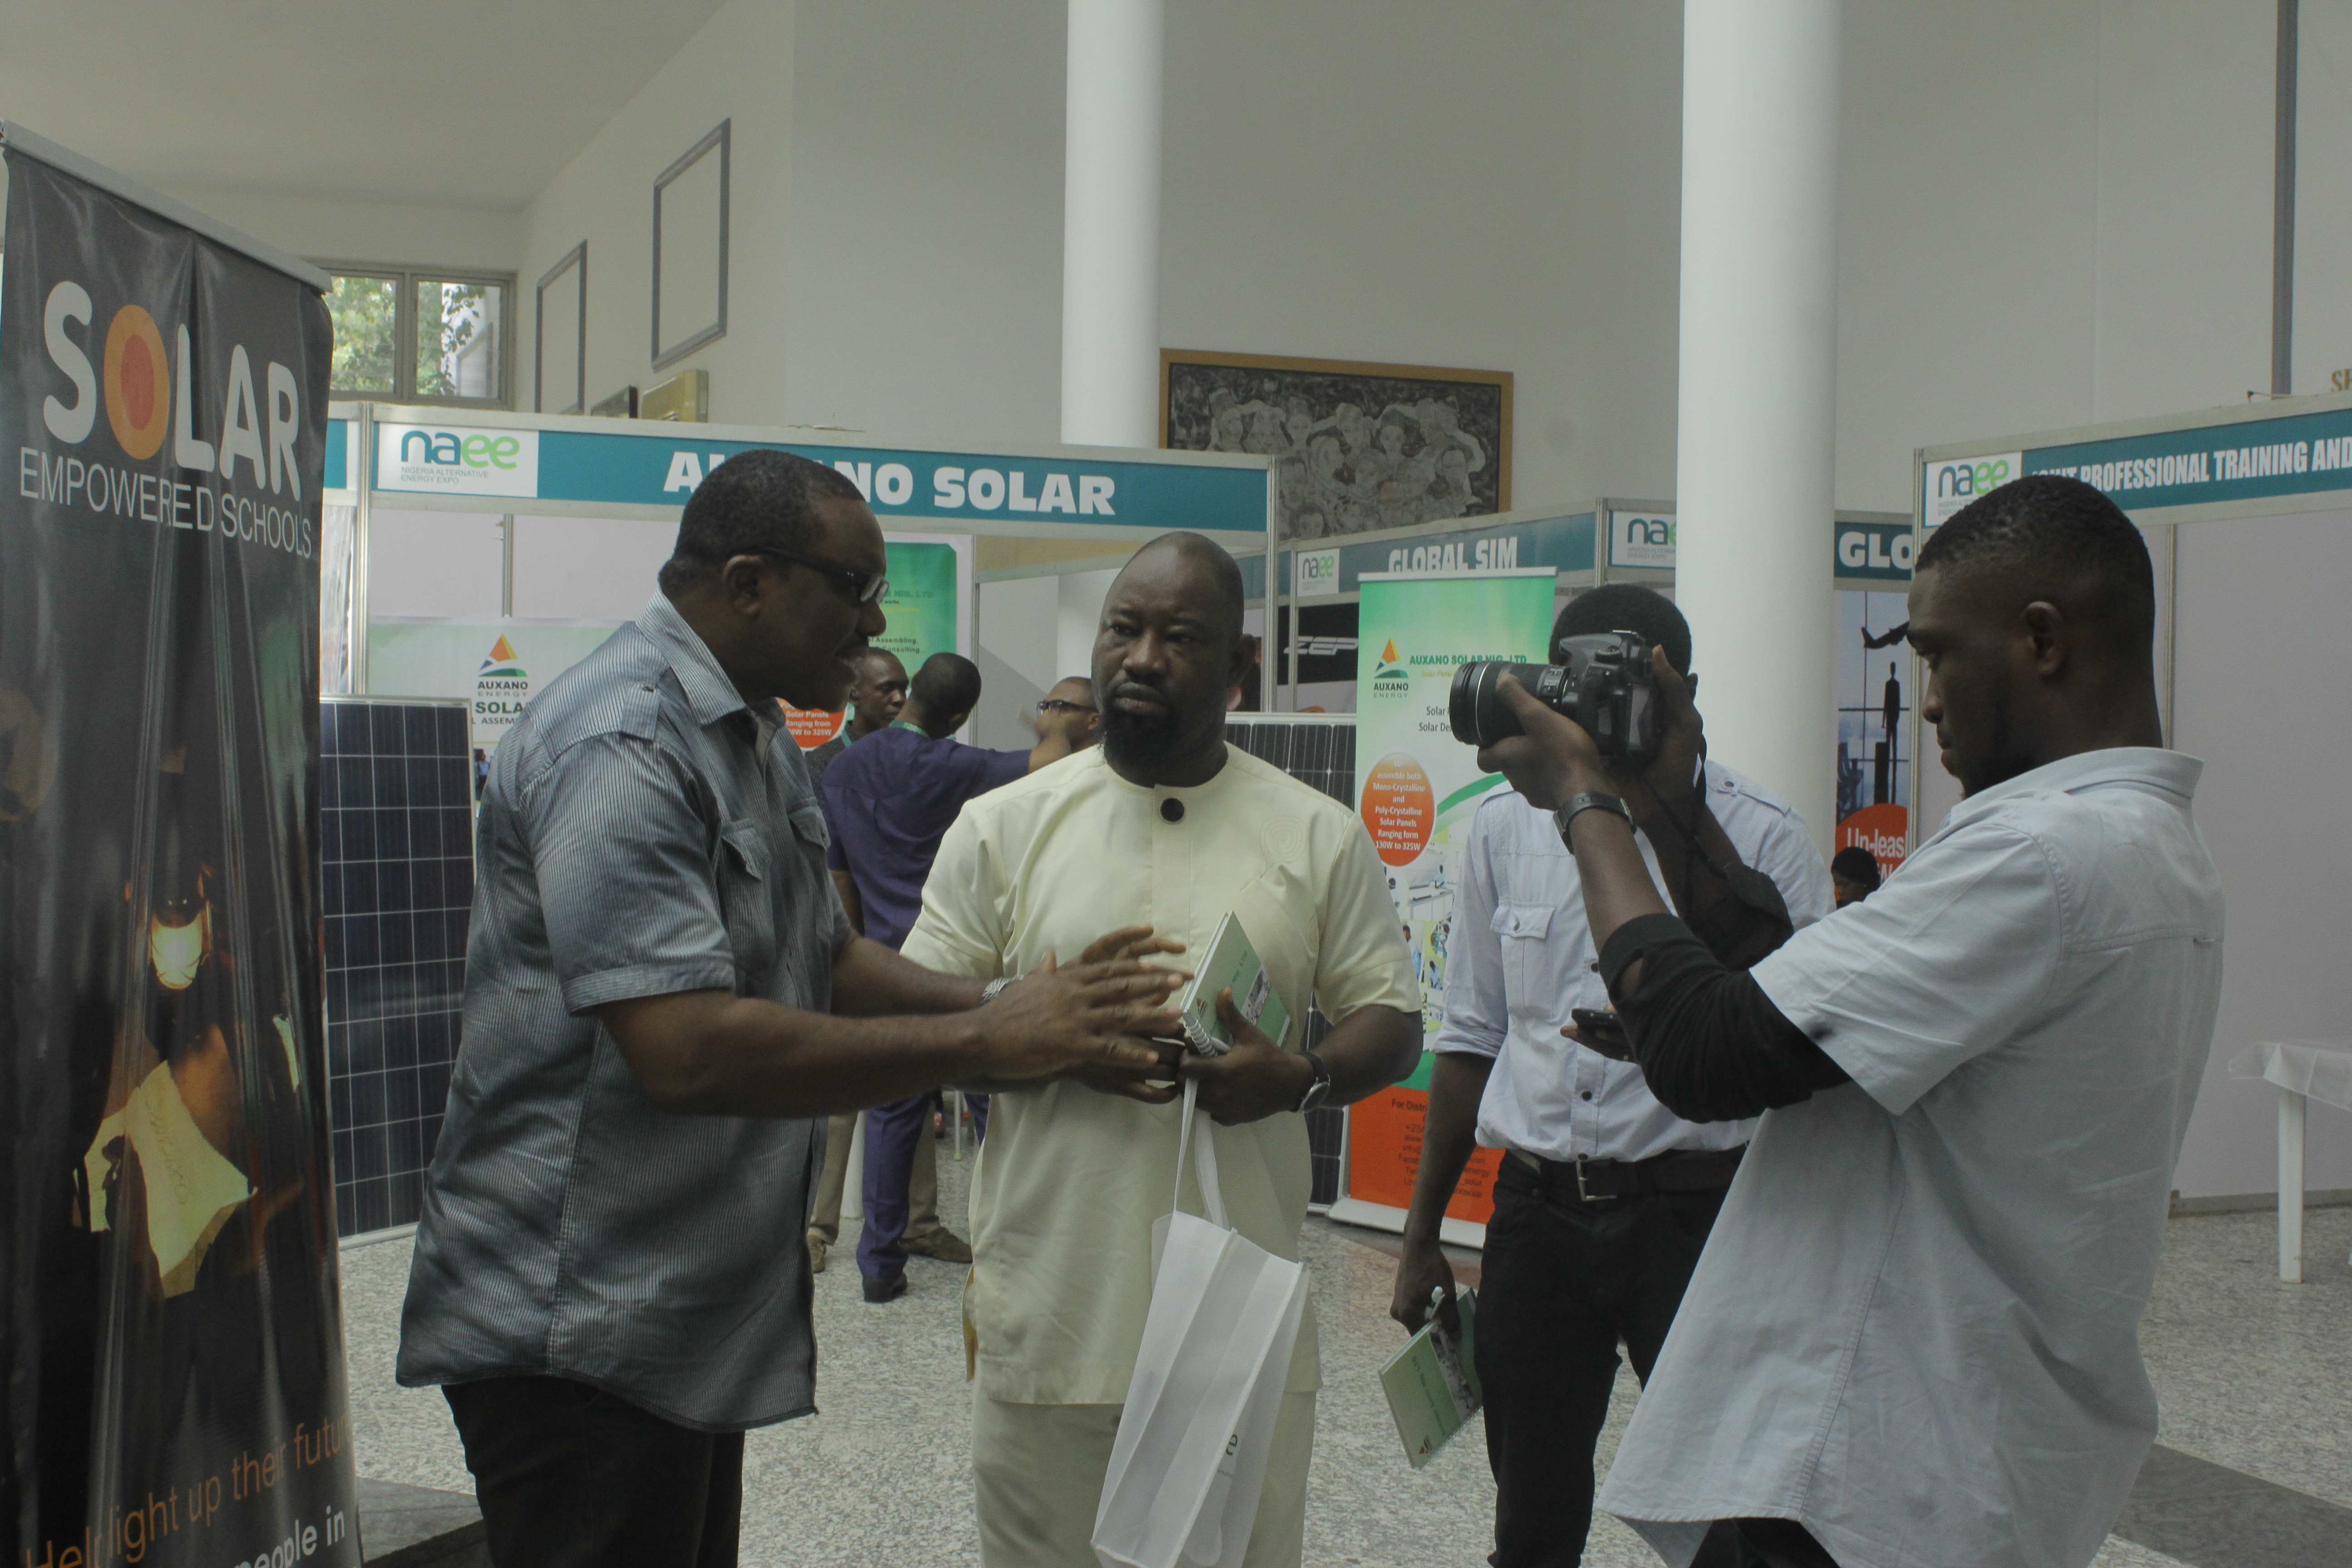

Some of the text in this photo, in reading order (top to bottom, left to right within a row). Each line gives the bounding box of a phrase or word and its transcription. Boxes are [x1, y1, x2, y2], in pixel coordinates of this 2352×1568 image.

[44, 280, 300, 502] SOLAR
[401, 430, 520, 470] naee
[2080, 436, 2352, 492] PROFESSIONAL TRAINING AND
[401, 466, 489, 478] NIGERIA ALTERNATIVE
[401, 474, 459, 484] ENERGY EXPO
[663, 451, 1116, 515] ANO SOLAR
[1938, 460, 2010, 498] naee
[20, 446, 312, 559] EMPOWERED SCHOOLS
[1388, 536, 1518, 572] GLOBAL SIM
[1838, 531, 1914, 570] GLO
[1303, 556, 1334, 579] naee
[1409, 655, 1449, 665] AUXANO
[1451, 655, 1483, 665] SOLAR
[478, 681, 529, 690] AUXANO
[1373, 682, 1409, 691] AUXANO
[475, 701, 524, 714] SOLA
[1426, 706, 1446, 715] Solar
[481, 716, 515, 725] ASSEM
[1419, 722, 1452, 732] Solar Des
[1373, 782, 1425, 793] Mono-Crystalline
[1375, 806, 1422, 816] Poly-Crystalline
[1380, 818, 1416, 828] Solar Panels
[1378, 829, 1402, 839] Ranging
[1403, 843, 1421, 851] 325W
[1847, 827, 1908, 858] Un-leas
[188, 1476, 221, 1528] up
[233, 1504, 345, 1568] eople in
